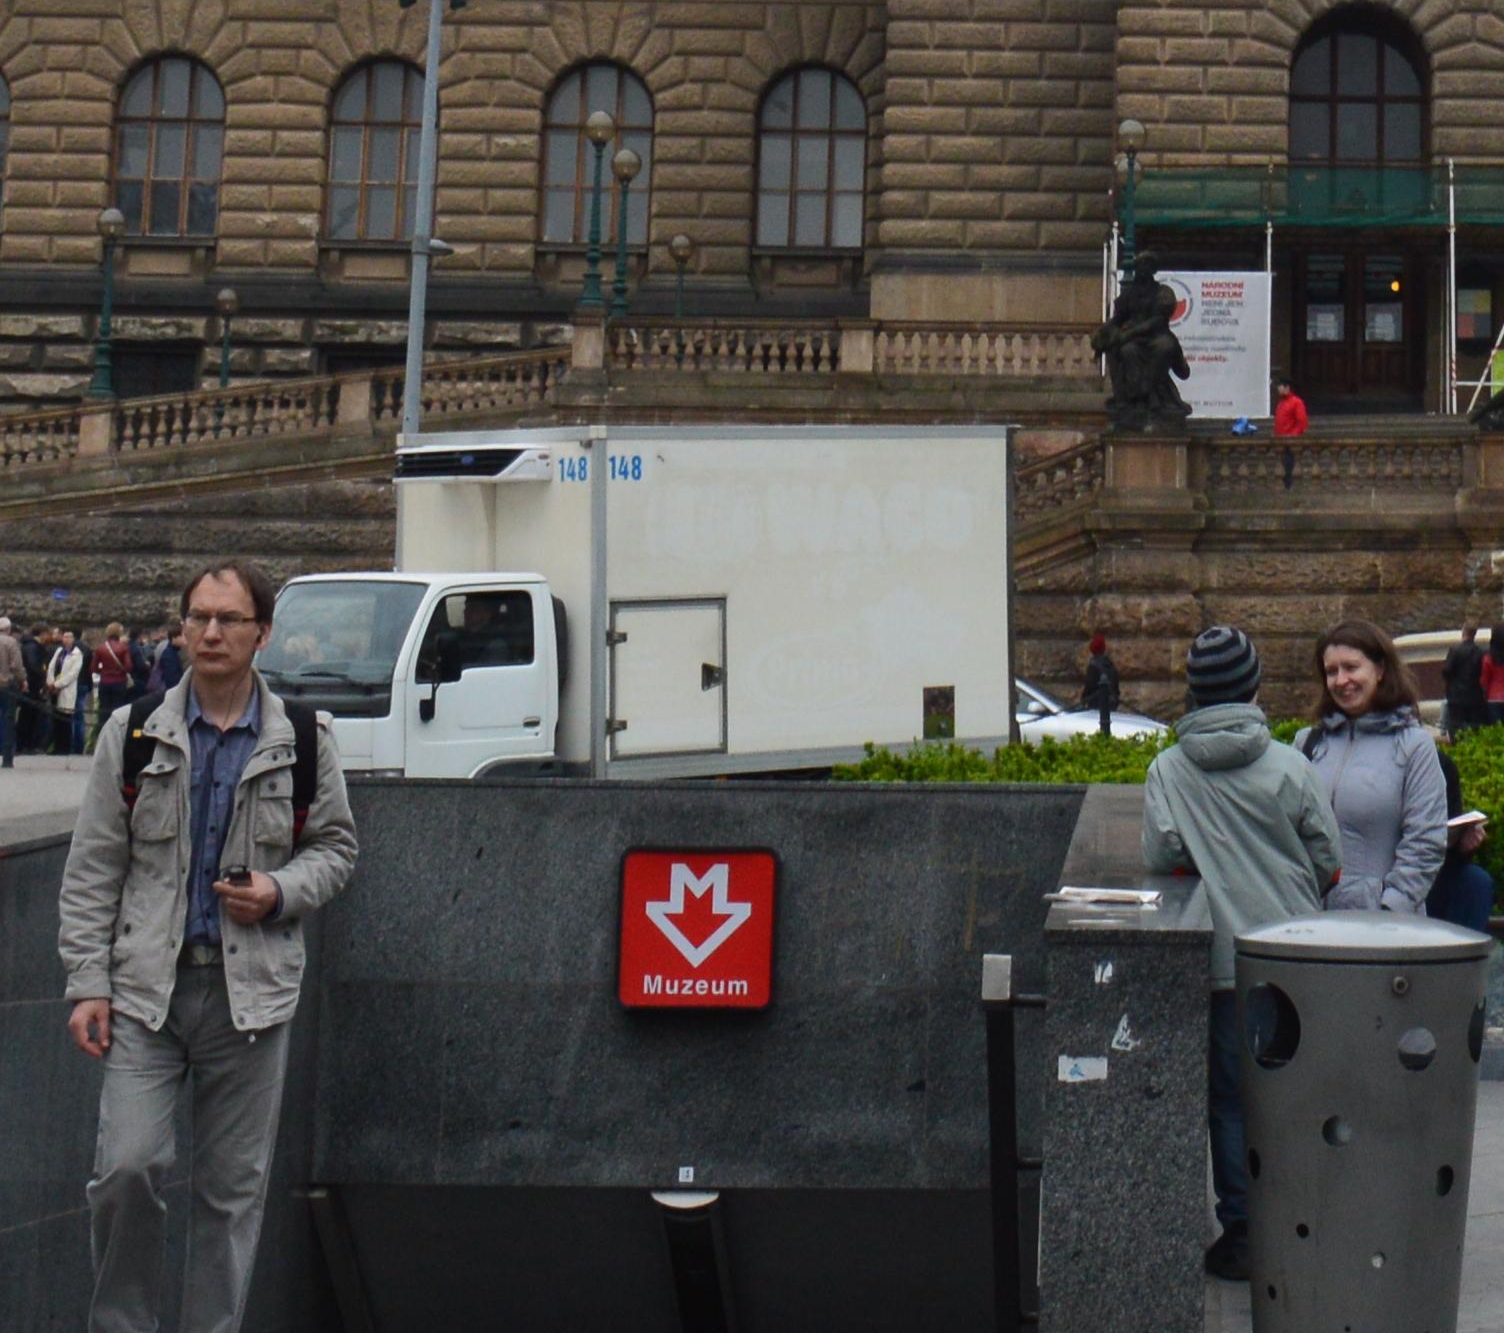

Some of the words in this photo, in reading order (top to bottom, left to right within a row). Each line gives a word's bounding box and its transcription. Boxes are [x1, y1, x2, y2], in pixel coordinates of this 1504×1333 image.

[558, 456, 588, 482] 148
[608, 454, 642, 481] 148
[643, 974, 748, 995] Muzeum
